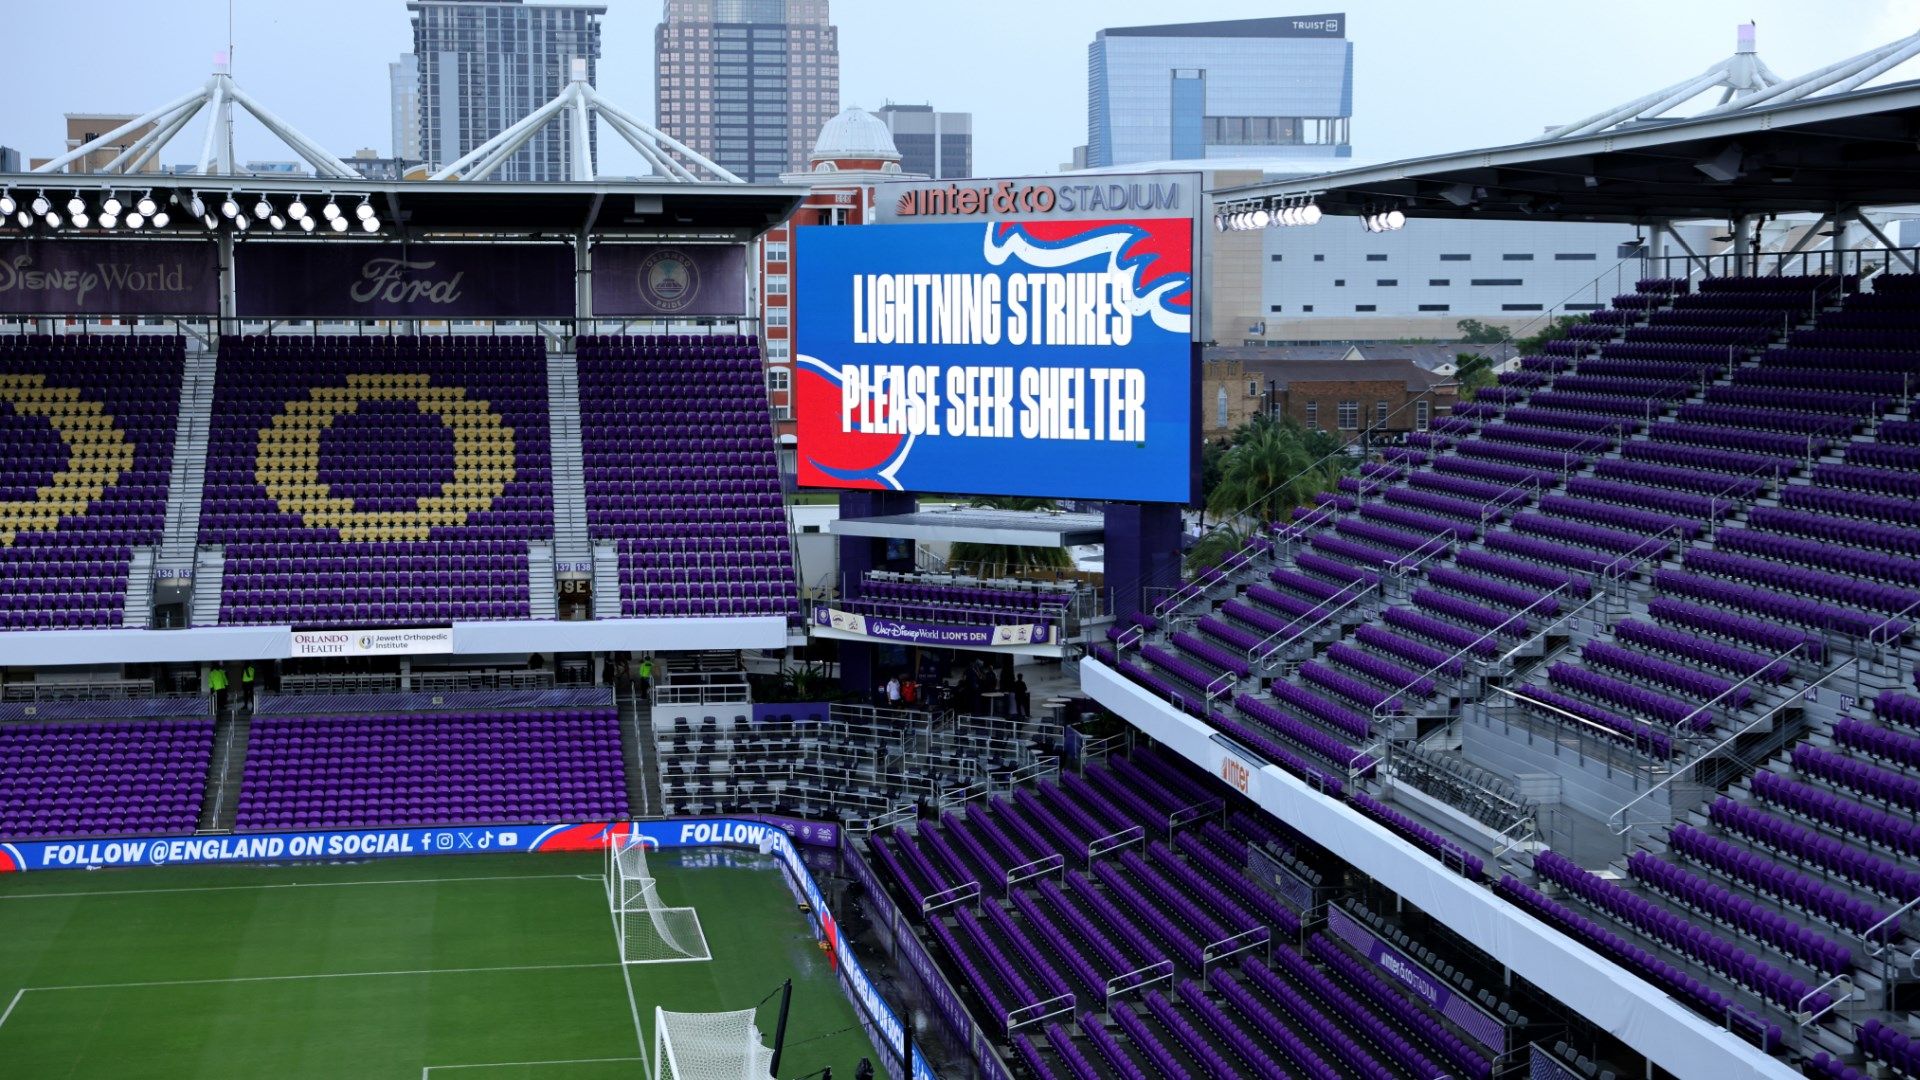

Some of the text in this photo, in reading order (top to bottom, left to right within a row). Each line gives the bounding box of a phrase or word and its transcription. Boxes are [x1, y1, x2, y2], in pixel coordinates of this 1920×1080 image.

[1292, 21, 1325, 30] TRUIST
[1058, 182, 1180, 212] STADIUM
[96, 263, 185, 292] World
[350, 257, 465, 304] Ford
[853, 272, 1134, 347] LIGHTNING STRIKES
[842, 364, 1146, 442] PLEASE SEEK SHELTER
[157, 570, 173, 578] 136
[180, 570, 192, 578] 13
[295, 634, 349, 644] ORLANDO
[403, 633, 448, 641] Orthopedic
[919, 628, 939, 640] World
[941, 632, 968, 641] LION'S
[969, 632, 987, 640] DEN
[301, 643, 344, 654] HEALTH
[375, 641, 409, 649] Institute
[680, 823, 765, 844] FOLLOW
[42, 843, 148, 865] FOLLOW
[149, 837, 285, 865] @ENGLAND
[289, 836, 323, 856] ON
[327, 833, 414, 855] SOCIAL
